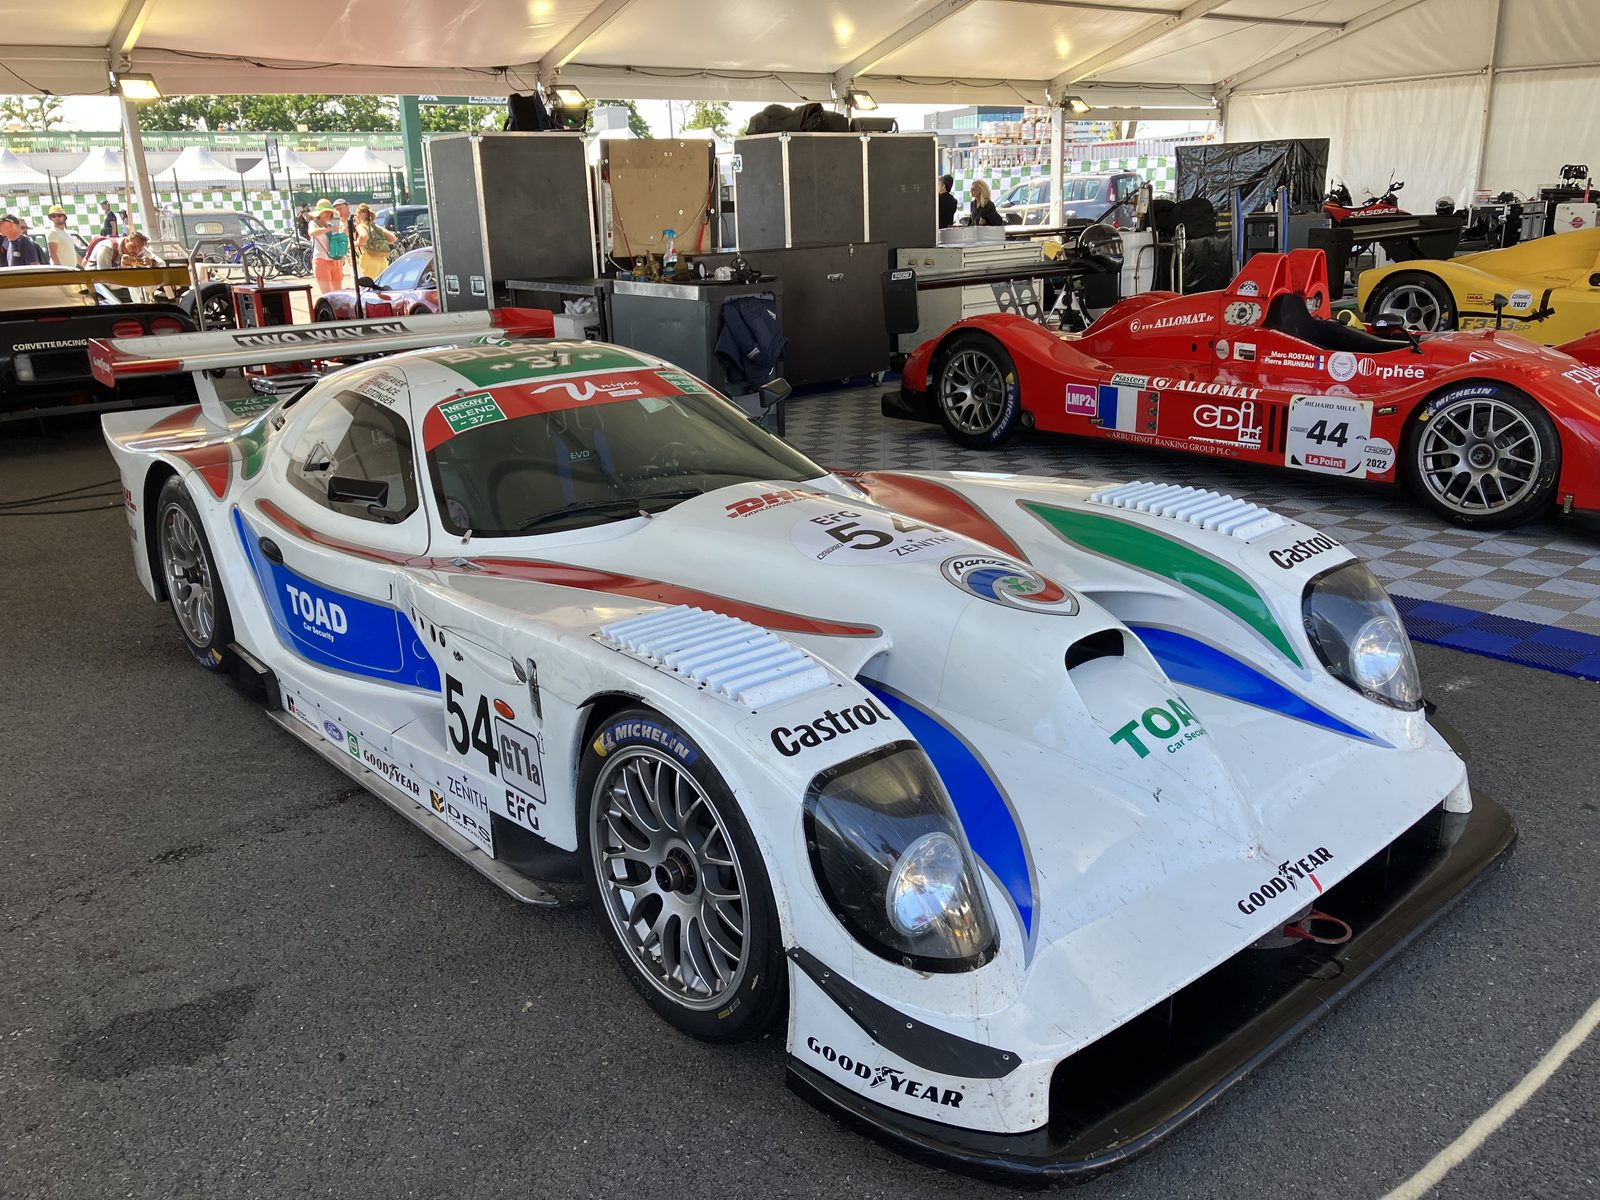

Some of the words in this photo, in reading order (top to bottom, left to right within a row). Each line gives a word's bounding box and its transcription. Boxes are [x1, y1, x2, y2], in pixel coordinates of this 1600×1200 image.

[237, 333, 301, 347] TWO
[305, 327, 365, 341] WAY
[371, 323, 403, 335] TV
[1264, 357, 1282, 365] Pierre
[1282, 359, 1314, 369] BRUNEAU
[1288, 352, 1315, 362] ROSTAN
[1113, 374, 1146, 384] Masters
[1067, 392, 1096, 408] LMP2b
[1173, 380, 1263, 400] ALLOMAT
[1436, 387, 1492, 408] MICHELIN
[448, 404, 496, 422] BLEND
[1304, 401, 1335, 410] RICHARD
[1336, 404, 1357, 412] MILLE
[470, 416, 485, 425] 37
[1112, 432, 1153, 446] ARBUTHNOT
[1155, 437, 1189, 450] BANKING
[1189, 443, 1215, 455] GROUP
[1215, 447, 1231, 456] PLC
[1306, 419, 1349, 448] 44
[570, 450, 590, 460] EVO
[1308, 455, 1318, 464] Le
[1318, 456, 1343, 468] Point
[1366, 458, 1387, 469] 2022
[810, 510, 862, 525] EFG
[889, 535, 955, 557] ZENITH
[1268, 532, 1341, 570] Castrol
[286, 583, 348, 635] TOAD
[303, 621, 312, 632] Car
[313, 625, 334, 643] Security
[445, 673, 500, 777] 54
[770, 697, 892, 757] Castrol
[615, 723, 689, 760] MICHELIN
[1167, 739, 1185, 754] Car
[500, 734, 541, 787] GT1a
[447, 775, 489, 814] ZENITH
[506, 789, 540, 831] EFG
